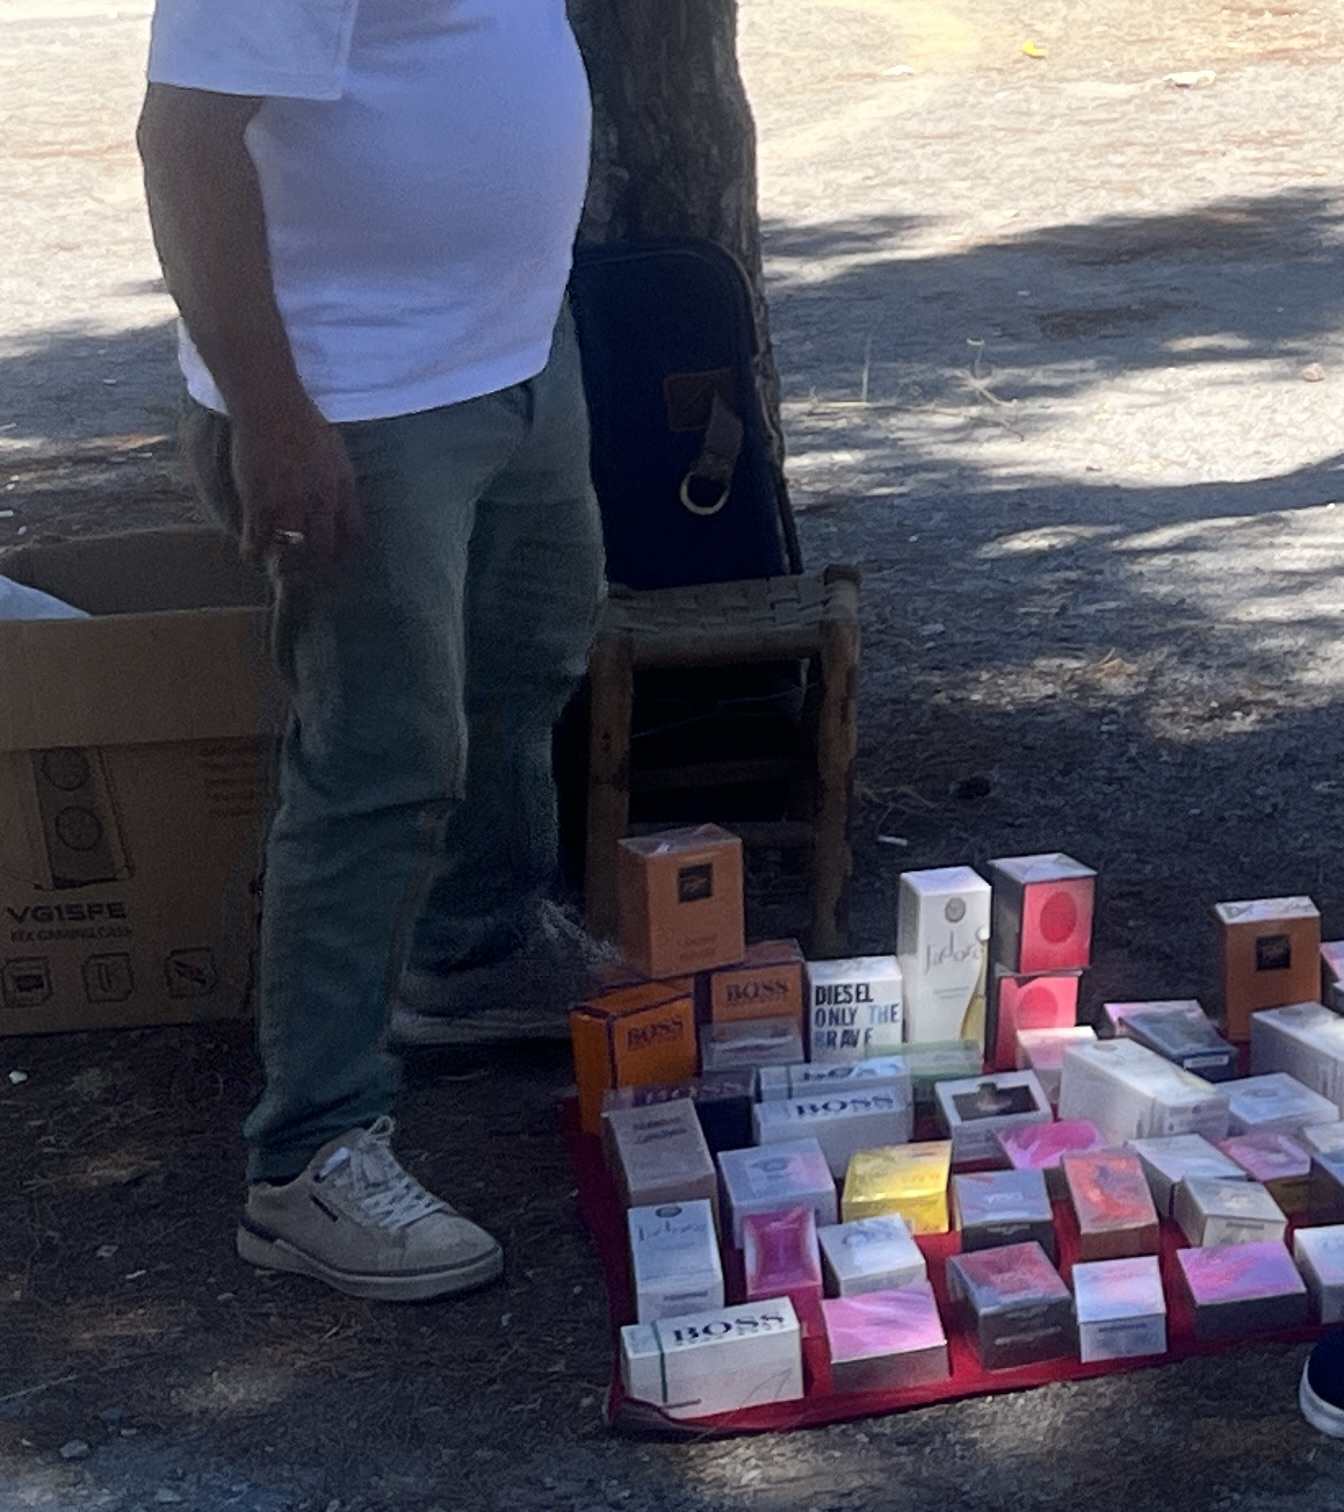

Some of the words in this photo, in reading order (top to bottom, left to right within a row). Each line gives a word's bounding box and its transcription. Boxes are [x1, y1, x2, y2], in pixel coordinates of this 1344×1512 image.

[726, 979, 789, 1003] BOSS
[815, 981, 873, 1006] DIESEL
[814, 1006, 858, 1028] ONLY
[869, 1003, 899, 1025] THE
[627, 1017, 684, 1046] BOSS
[673, 1312, 785, 1345] BOSS
